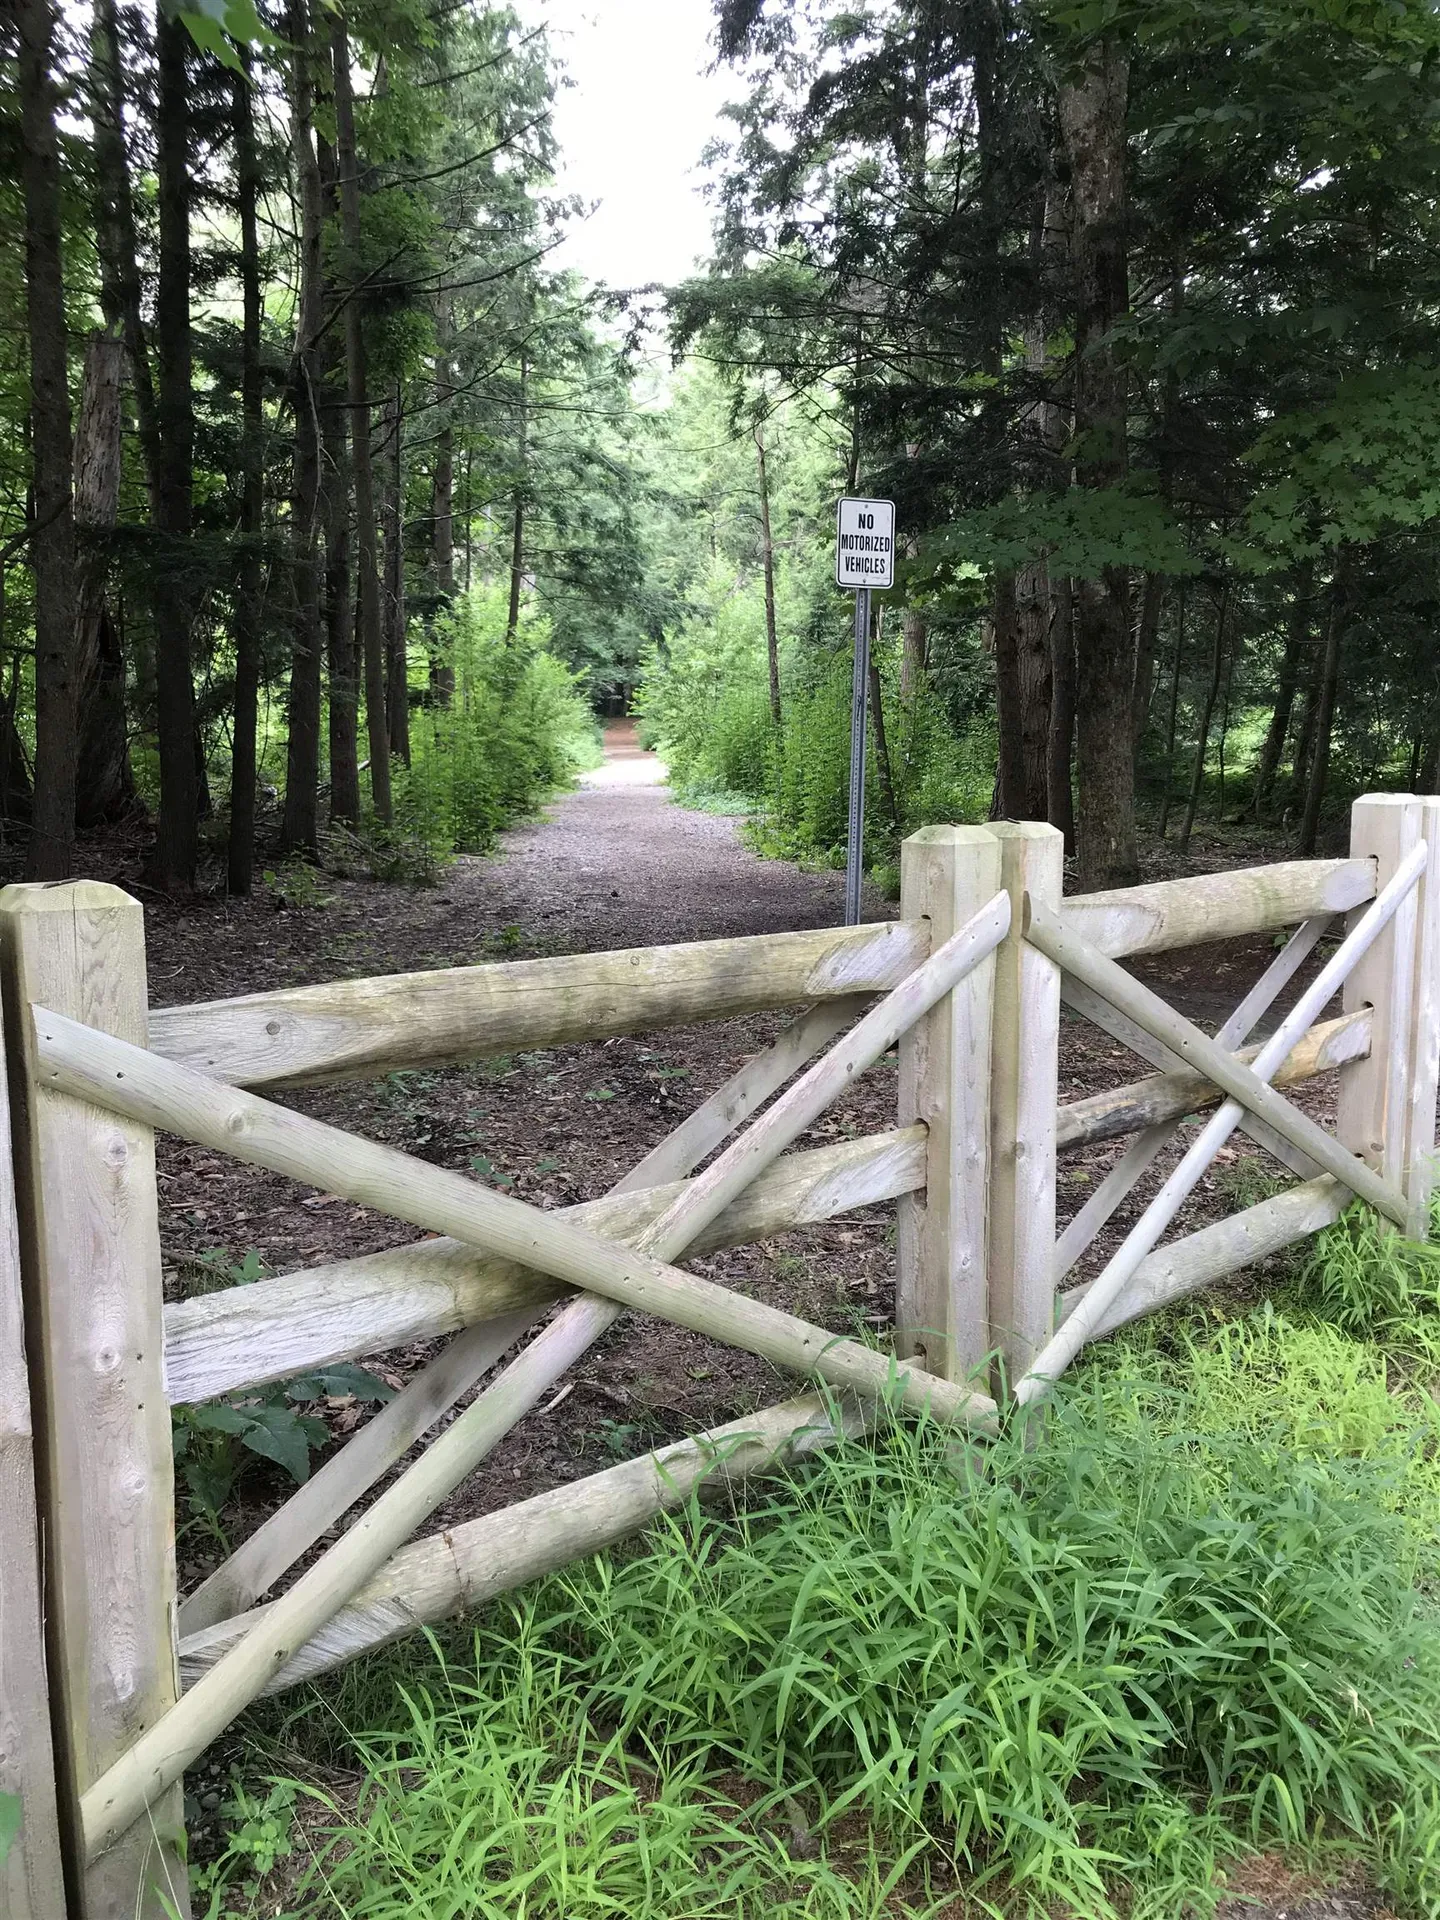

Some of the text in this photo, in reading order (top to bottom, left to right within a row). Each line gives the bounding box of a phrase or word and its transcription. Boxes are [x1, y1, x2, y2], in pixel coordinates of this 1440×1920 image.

[858, 513, 874, 530] NO
[841, 534, 890, 552] MOTORIZED
[845, 556, 885, 574] VEHICLES
